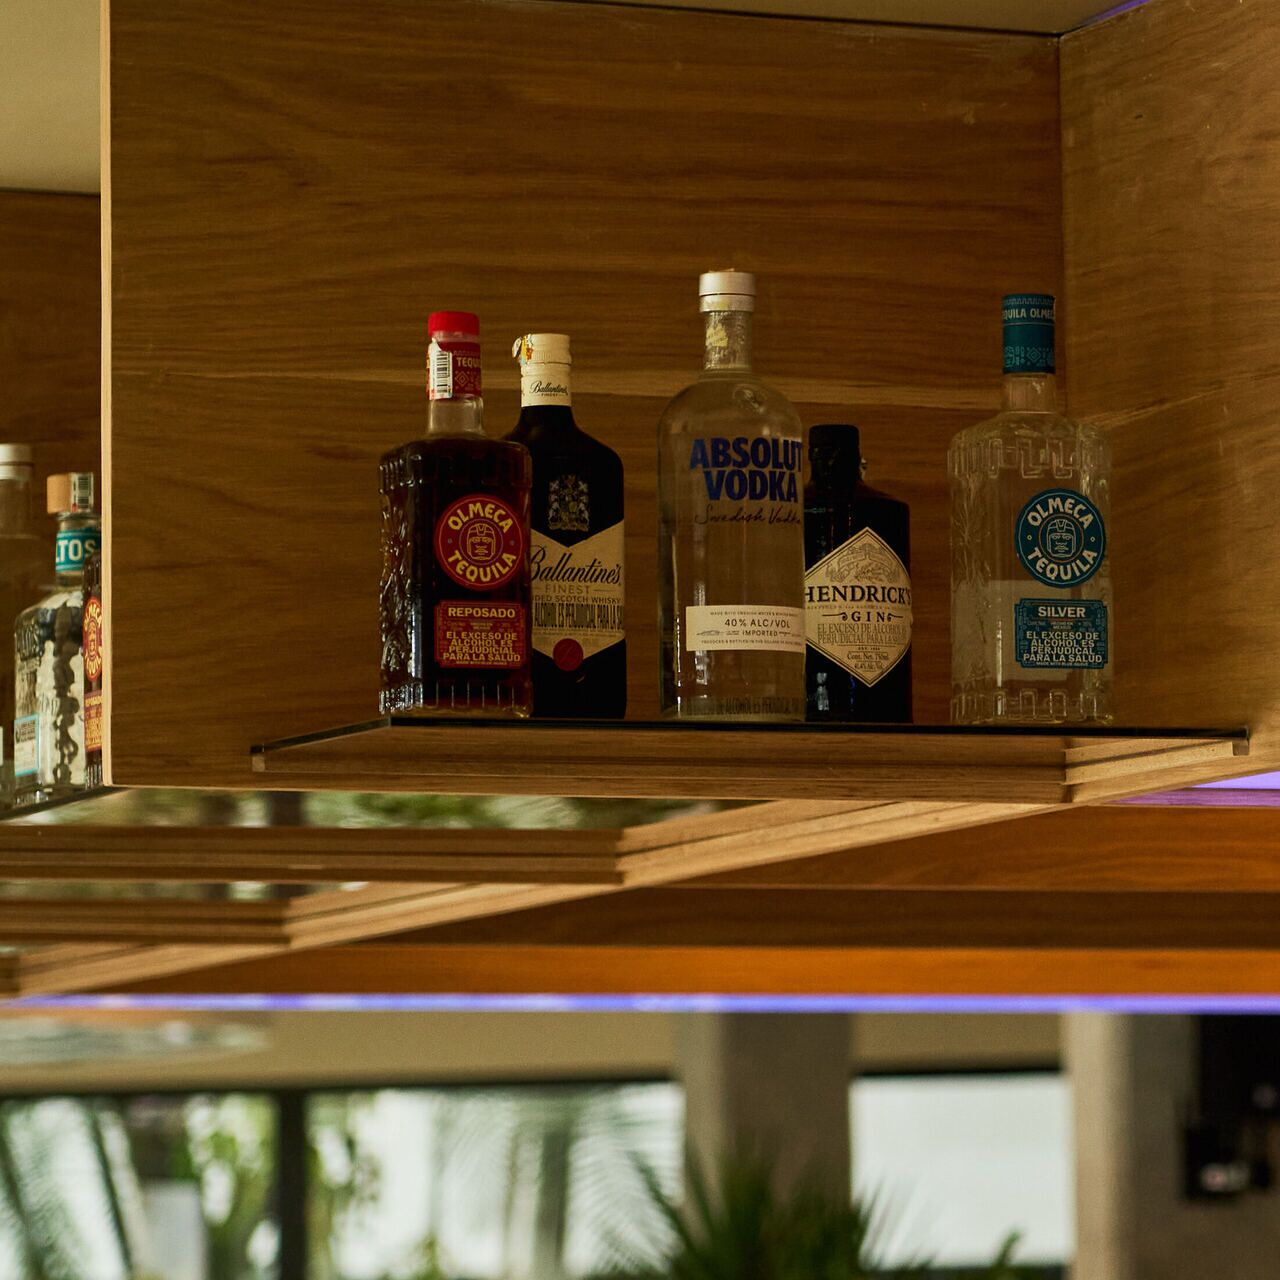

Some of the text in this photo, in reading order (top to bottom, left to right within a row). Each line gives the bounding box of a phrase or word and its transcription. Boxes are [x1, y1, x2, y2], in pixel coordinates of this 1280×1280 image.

[689, 436, 803, 472] ABSOLUT
[704, 469, 799, 503] VODKA
[448, 502, 514, 533] OLMECA
[695, 503, 766, 525] Swedish
[1027, 496, 1095, 530] OLMECA
[448, 550, 518, 582] TEQUILA
[531, 544, 622, 585] Ballantine's
[1027, 547, 1098, 581] TEQUILA
[545, 584, 591, 594] FINEST
[555, 595, 590, 603] SCOTCH
[591, 597, 622, 605] WHISKY
[447, 607, 516, 618] REPOSADO
[851, 611, 886, 622] GIN
[1038, 606, 1087, 619] SILVER
[725, 618, 791, 629] 40% ALC/VOL
[828, 623, 860, 634] EXCESO
[446, 631, 518, 641] EL EXCESO DE
[1026, 631, 1100, 640] EL EXCESO DE
[450, 639, 514, 648] ALCOHOL ES
[1031, 639, 1096, 648] ALCOHOL ES
[442, 652, 521, 662] PARA LA SALUD
[1023, 652, 1103, 663] PARA LA SALUD
